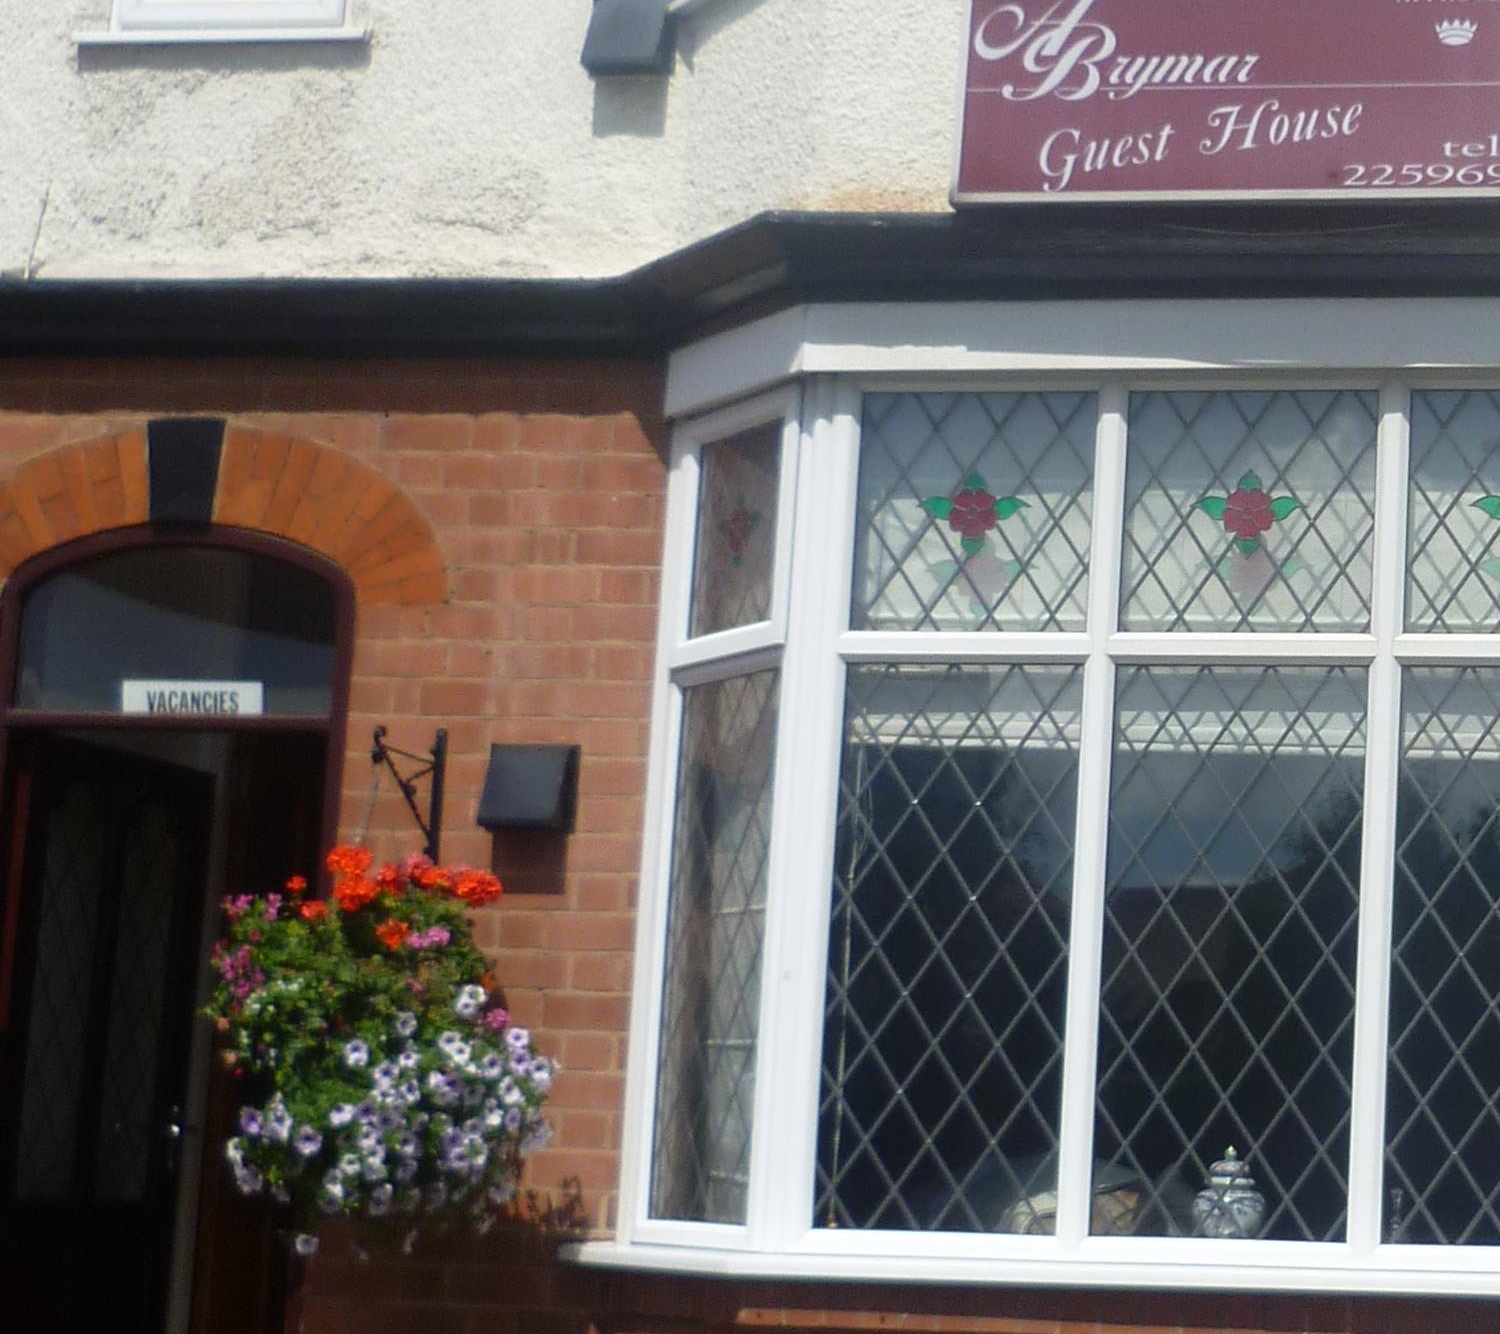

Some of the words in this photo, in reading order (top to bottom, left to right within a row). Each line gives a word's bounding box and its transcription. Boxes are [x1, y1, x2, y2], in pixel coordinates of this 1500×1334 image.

[1038, 123, 1176, 192] Guest
[1199, 98, 1364, 155] House
[147, 690, 240, 714] VACANCIES
